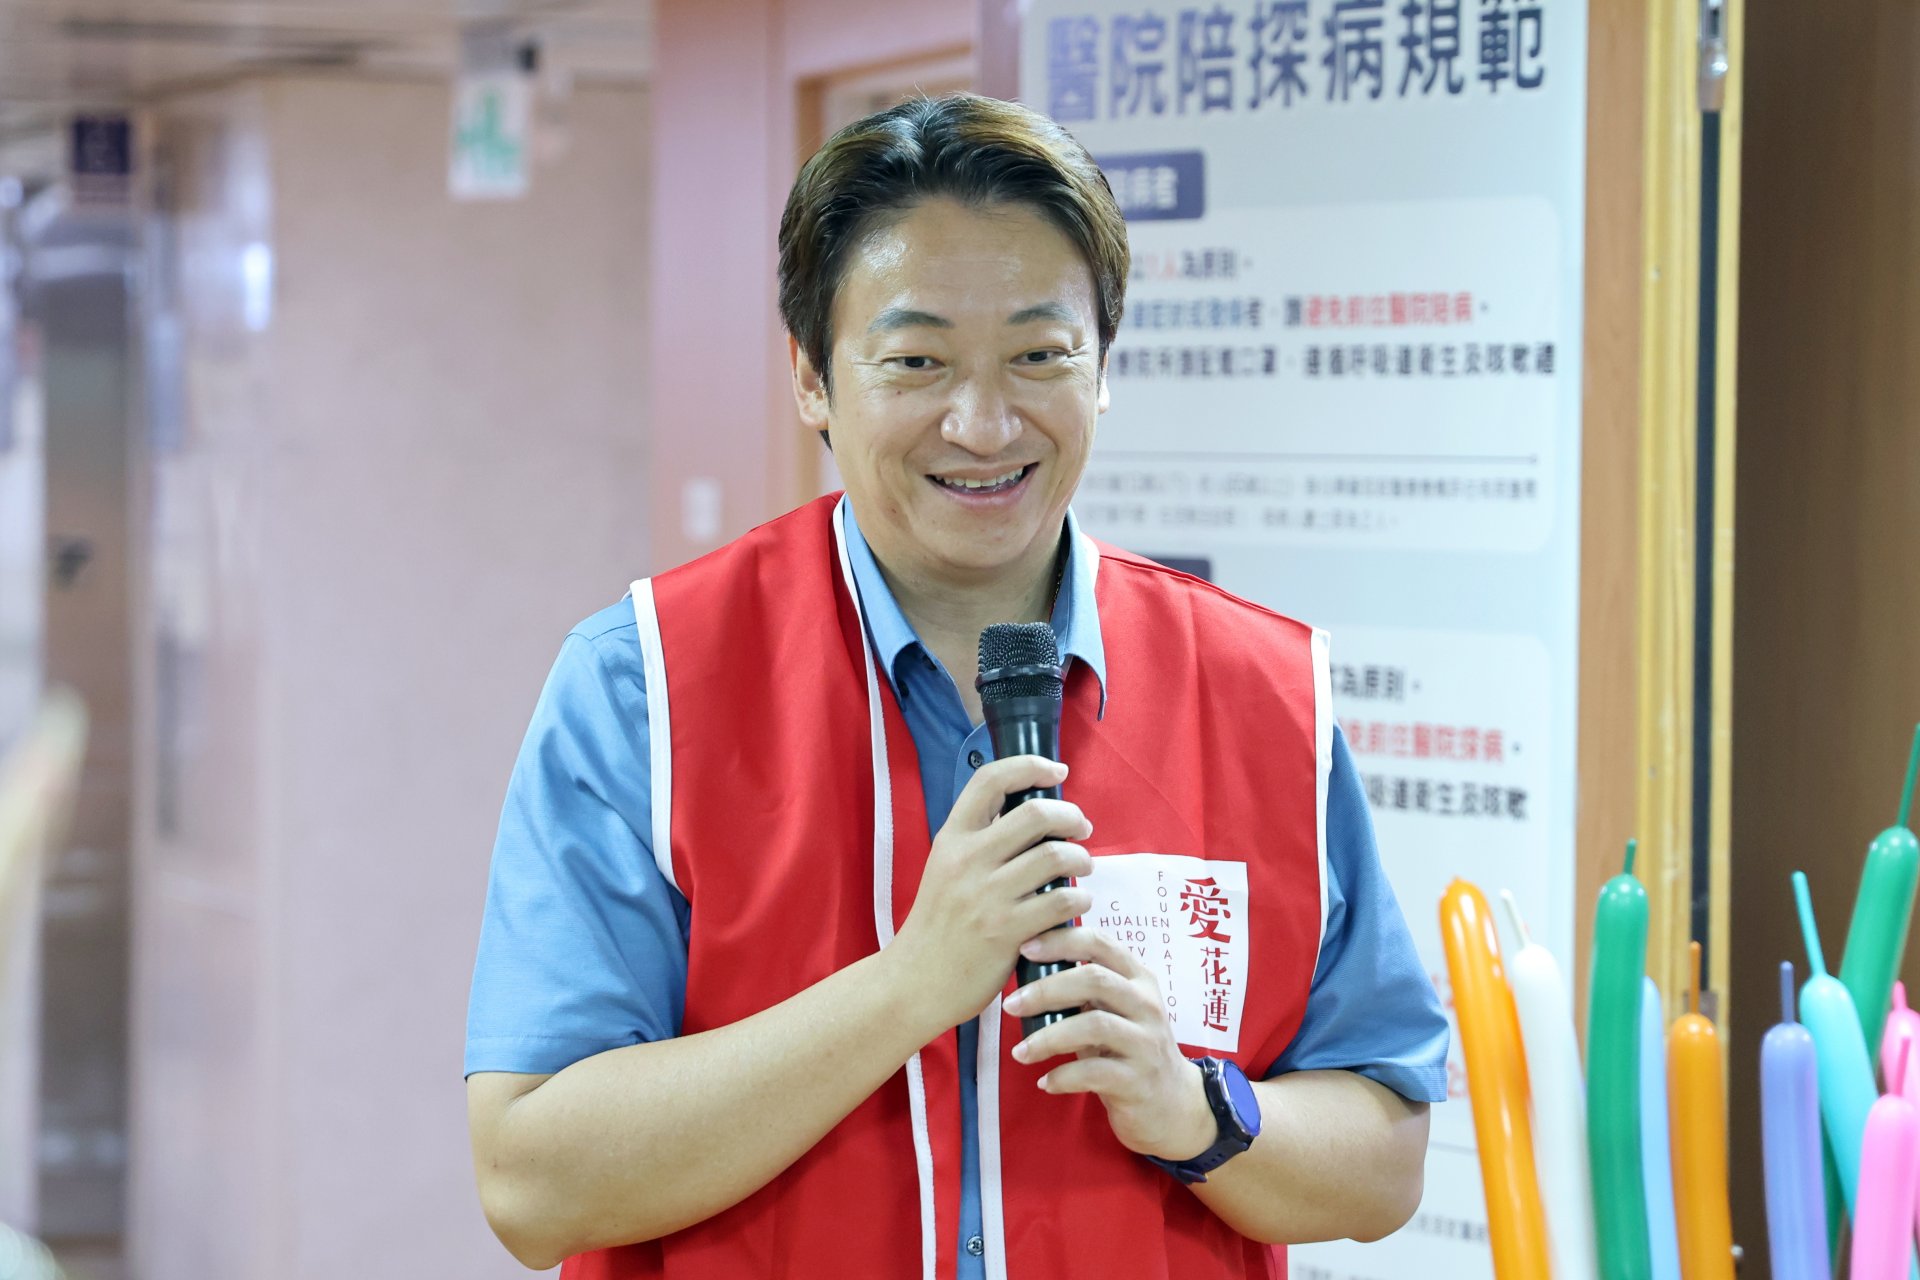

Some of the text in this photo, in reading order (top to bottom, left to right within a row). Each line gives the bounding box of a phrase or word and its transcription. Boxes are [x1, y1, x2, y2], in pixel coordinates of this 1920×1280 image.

[1048, 0, 1544, 120] 醫院陪探病規範
[1340, 717, 1521, 763] 免前往醫院探病。
[1099, 915, 1170, 929] HUALIEN
[1179, 876, 1233, 1033] 愛花蓮
